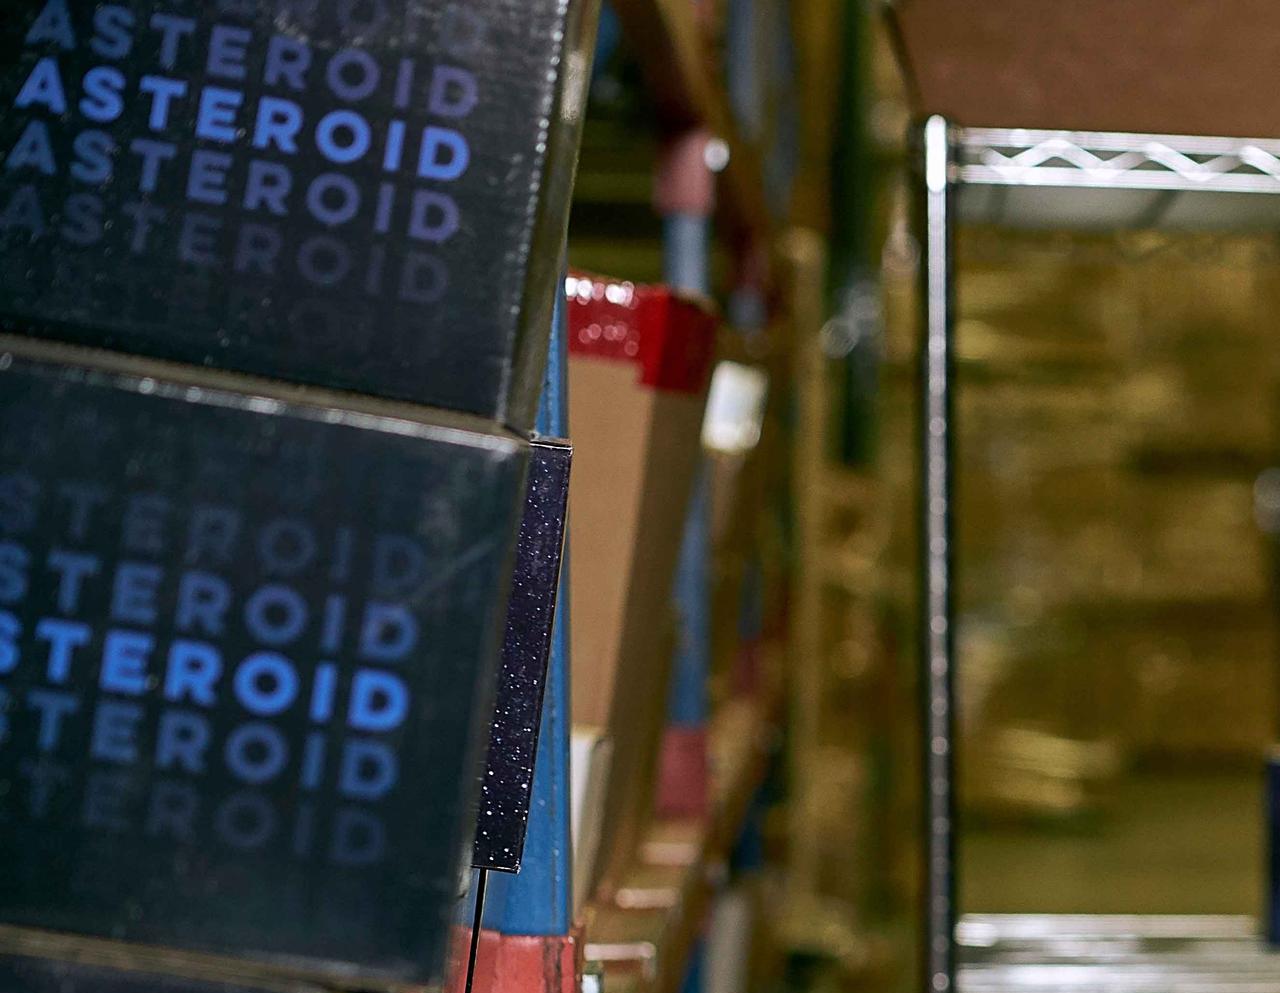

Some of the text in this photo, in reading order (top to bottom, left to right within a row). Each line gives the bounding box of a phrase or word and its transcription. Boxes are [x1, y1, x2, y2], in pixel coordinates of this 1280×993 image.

[25, 0, 478, 118] ASTEROID
[14, 57, 470, 181] ASTEROID
[4, 120, 460, 243] ASTEROID
[0, 185, 449, 298] ASTEROID
[0, 684, 400, 799] TEROID
